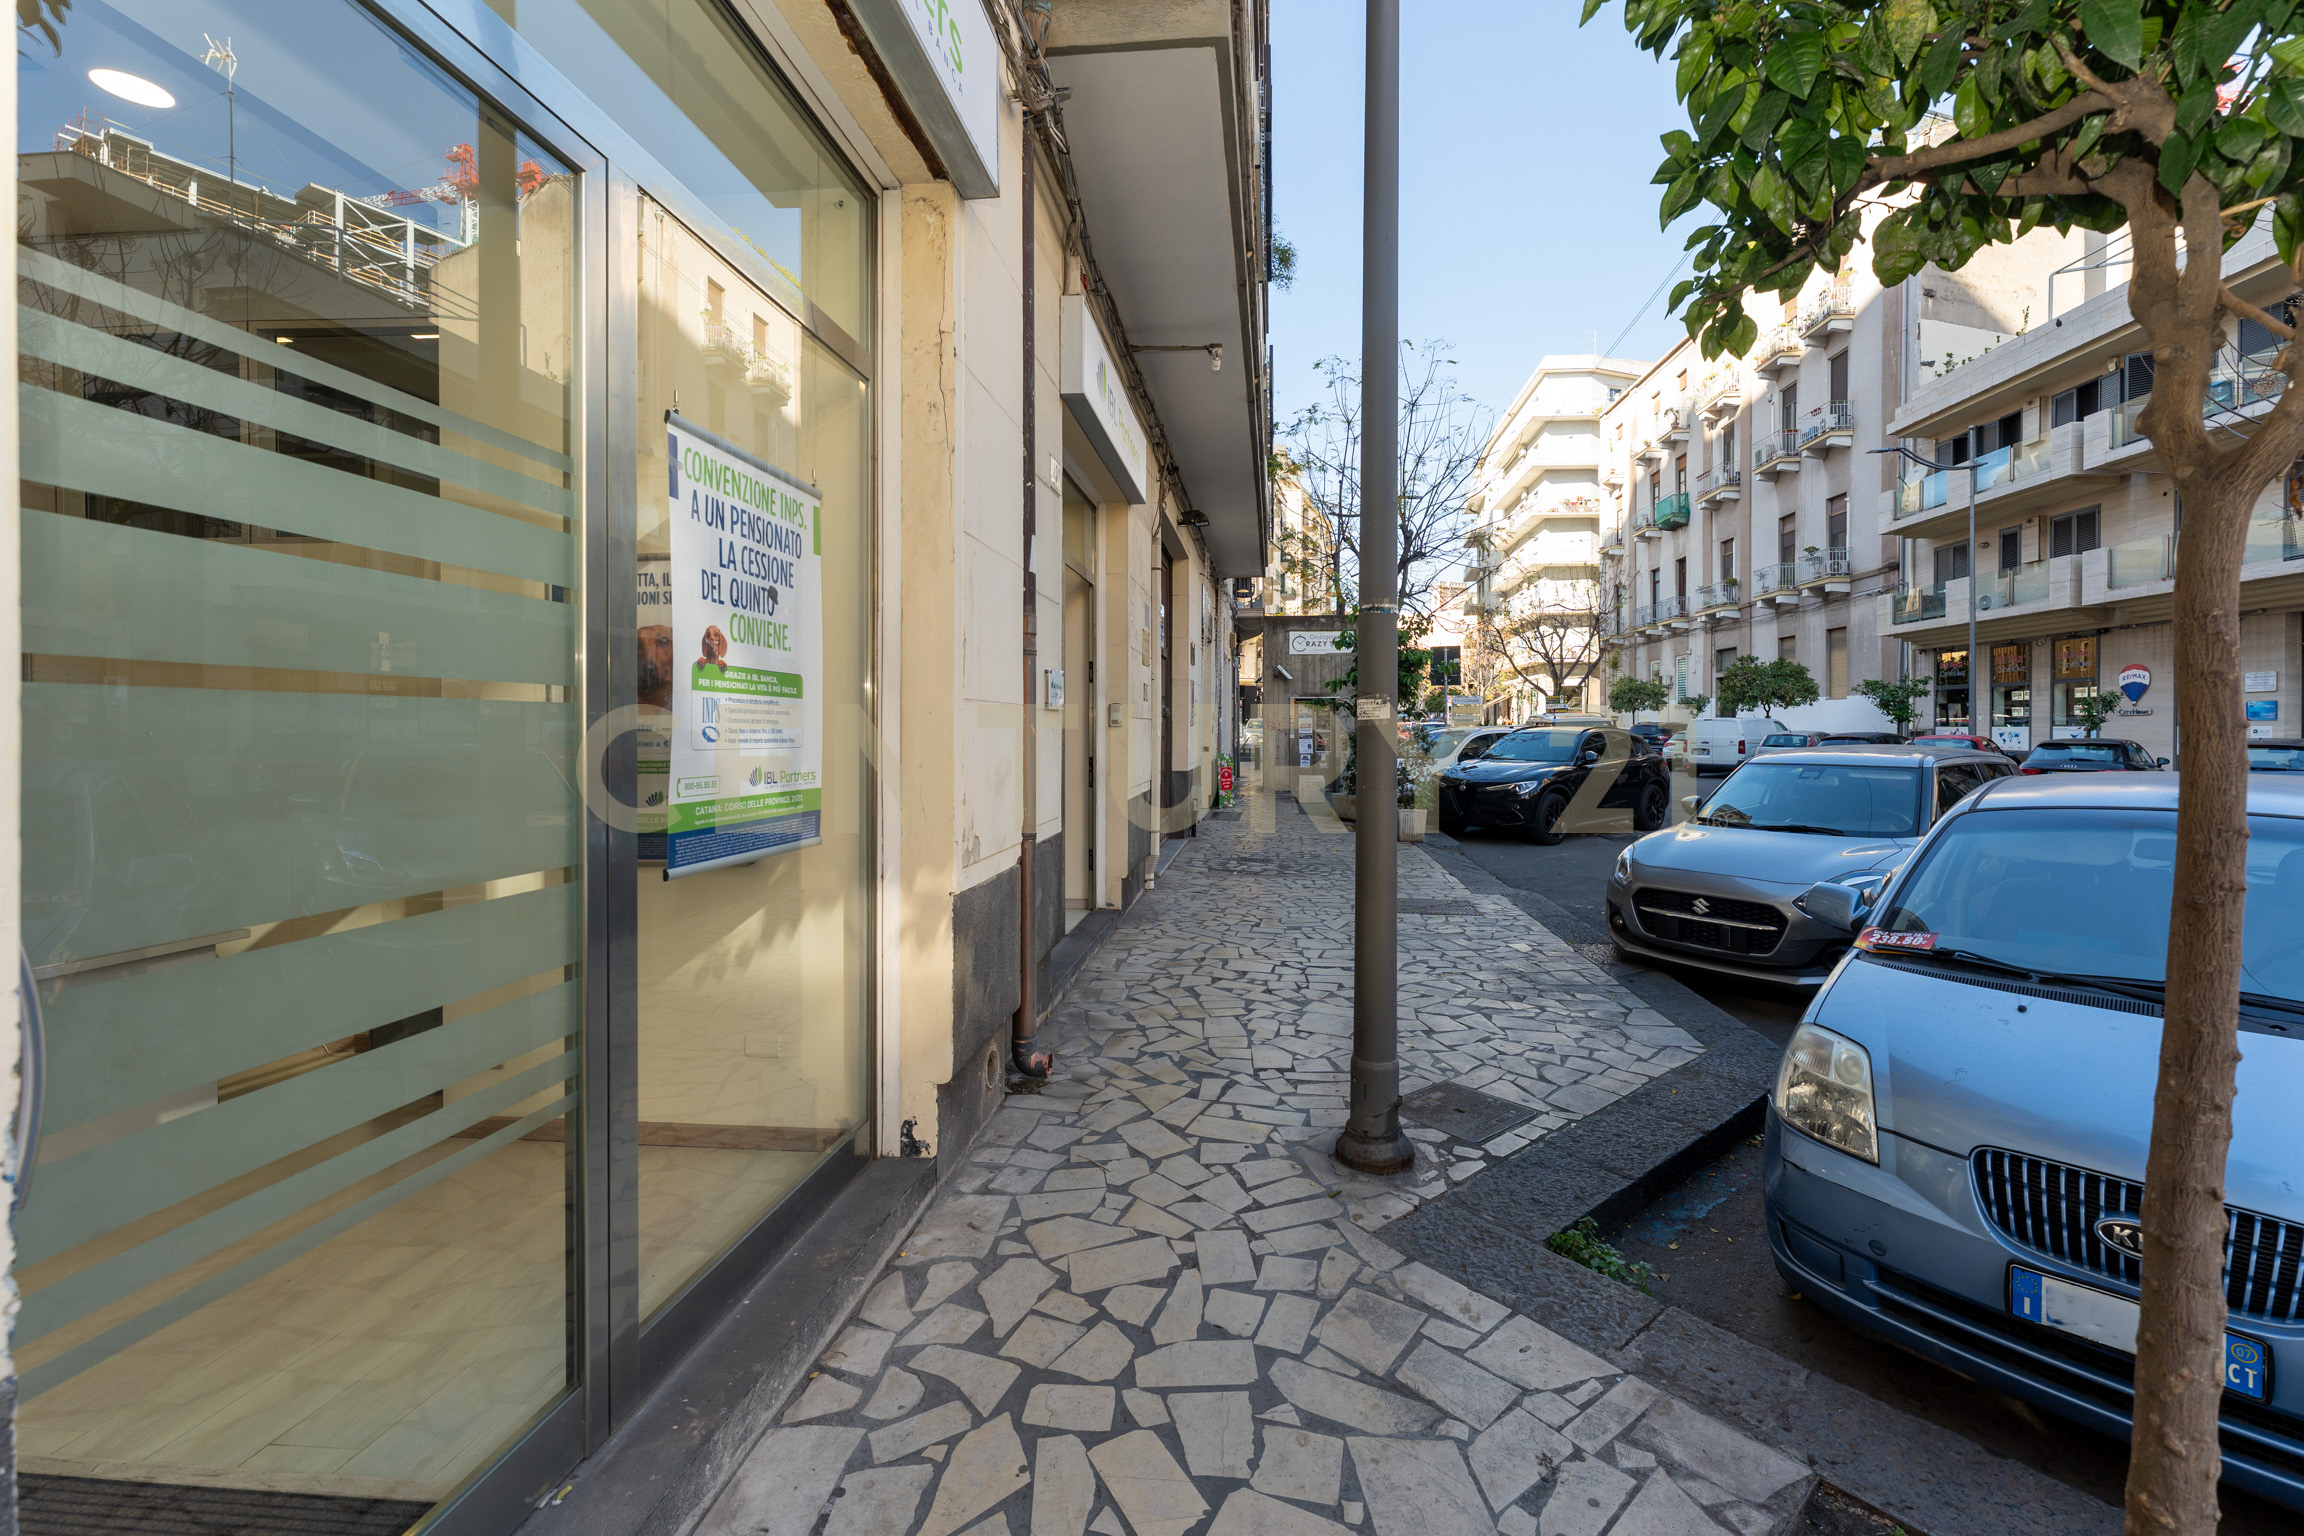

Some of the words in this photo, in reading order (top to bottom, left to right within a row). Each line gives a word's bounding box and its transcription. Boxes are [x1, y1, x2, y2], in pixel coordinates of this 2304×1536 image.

[684, 447, 777, 516] CONVENZIONE
[780, 492, 807, 530] INPS.
[691, 489, 700, 522] A
[705, 494, 725, 531] UN
[730, 504, 802, 559] PENSIONATO
[719, 537, 737, 571] LA
[741, 545, 794, 589] CESSIONE
[701, 568, 725, 605] DEL
[729, 577, 775, 616] QUINTO
[729, 612, 792, 653] CONVIENE.
[698, 678, 711, 687] PER
[714, 680, 748, 690] PENSIONATI
[757, 684, 768, 692] VITA
[724, 670, 746, 680] GRAZIE
[2122, 673, 2147, 681] RE/MAX
[702, 696, 720, 723] INPS
[764, 771, 778, 785] IBL
[780, 770, 816, 784] Partners
[725, 801, 747, 812] CORSO
[2112, 1225, 2144, 1250] KI
[2023, 1296, 2031, 1315] I
[2236, 1347, 2252, 1360] 07
[2228, 1363, 2258, 1389] CT
